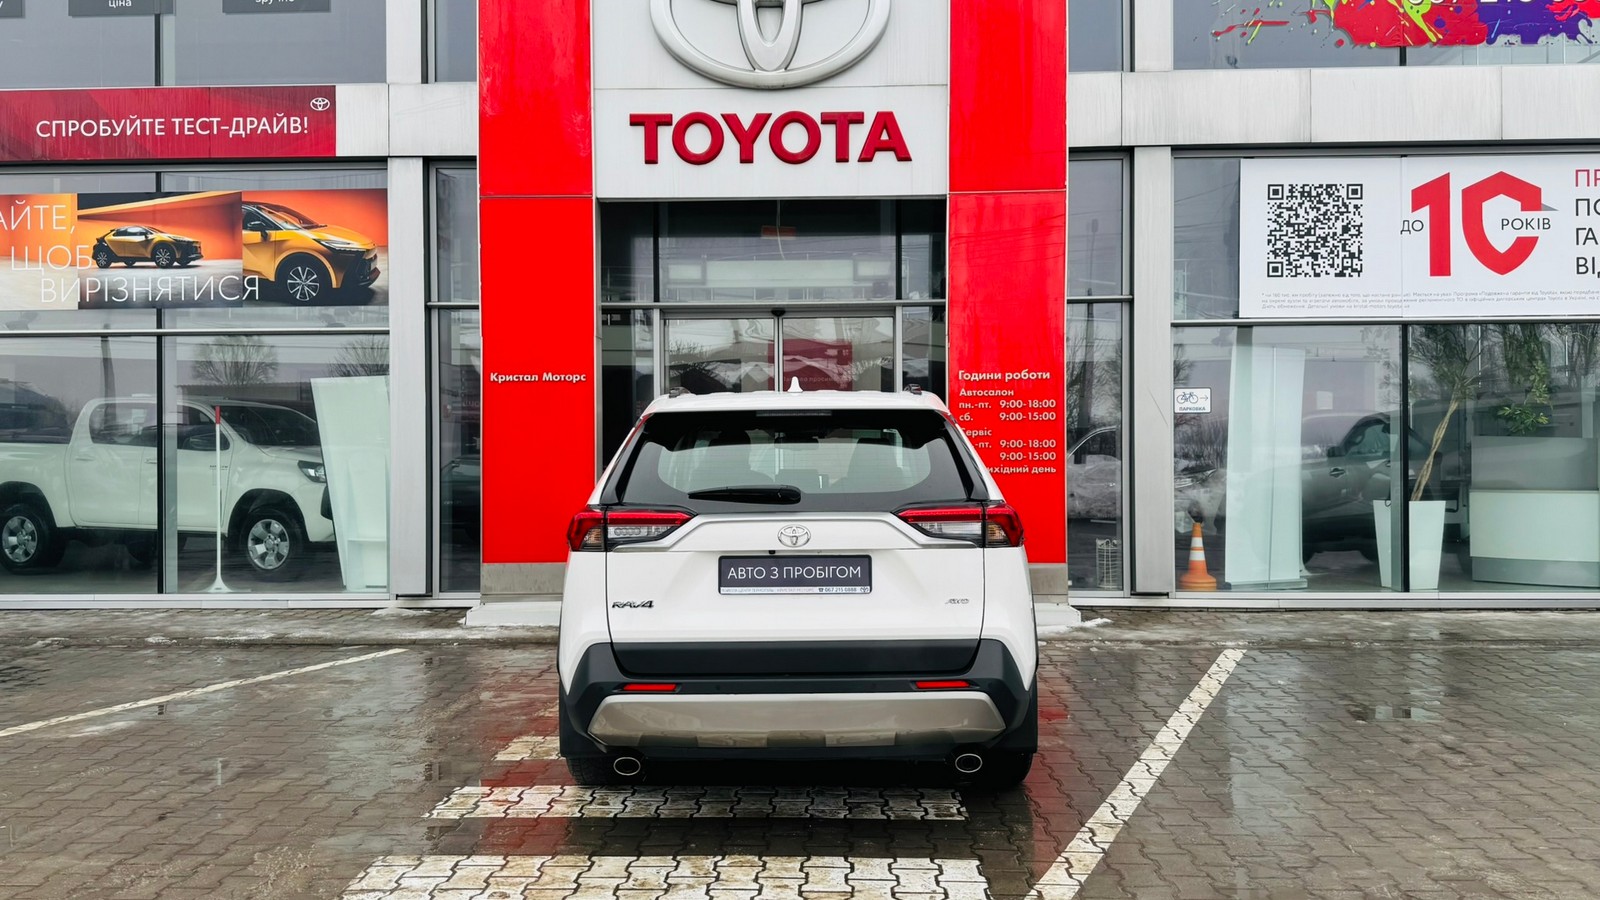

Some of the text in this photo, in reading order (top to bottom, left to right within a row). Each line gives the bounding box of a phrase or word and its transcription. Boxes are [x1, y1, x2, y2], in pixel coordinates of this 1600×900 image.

[36, 113, 309, 138] СПРОБУЙТЕ ТЕСТ-ДРАЙВ!
[629, 110, 912, 165] TOYOTA
[1400, 219, 1424, 235] ДО
[1501, 217, 1551, 231] РОКІВ
[11, 245, 92, 275] ЩОБ
[41, 275, 259, 303] ВИРІЗНЯТИСЯ
[490, 372, 586, 383] Кристал Моторс
[959, 369, 1050, 382] Години роботи
[959, 388, 1014, 397] Автосалон
[959, 401, 992, 409] пн.-пт.
[959, 412, 973, 421] сб.
[987, 464, 1056, 474] ихідний день
[727, 567, 766, 579] АВТО
[783, 566, 861, 579] ПРОБІГОМ
[612, 600, 654, 609] RAV4
